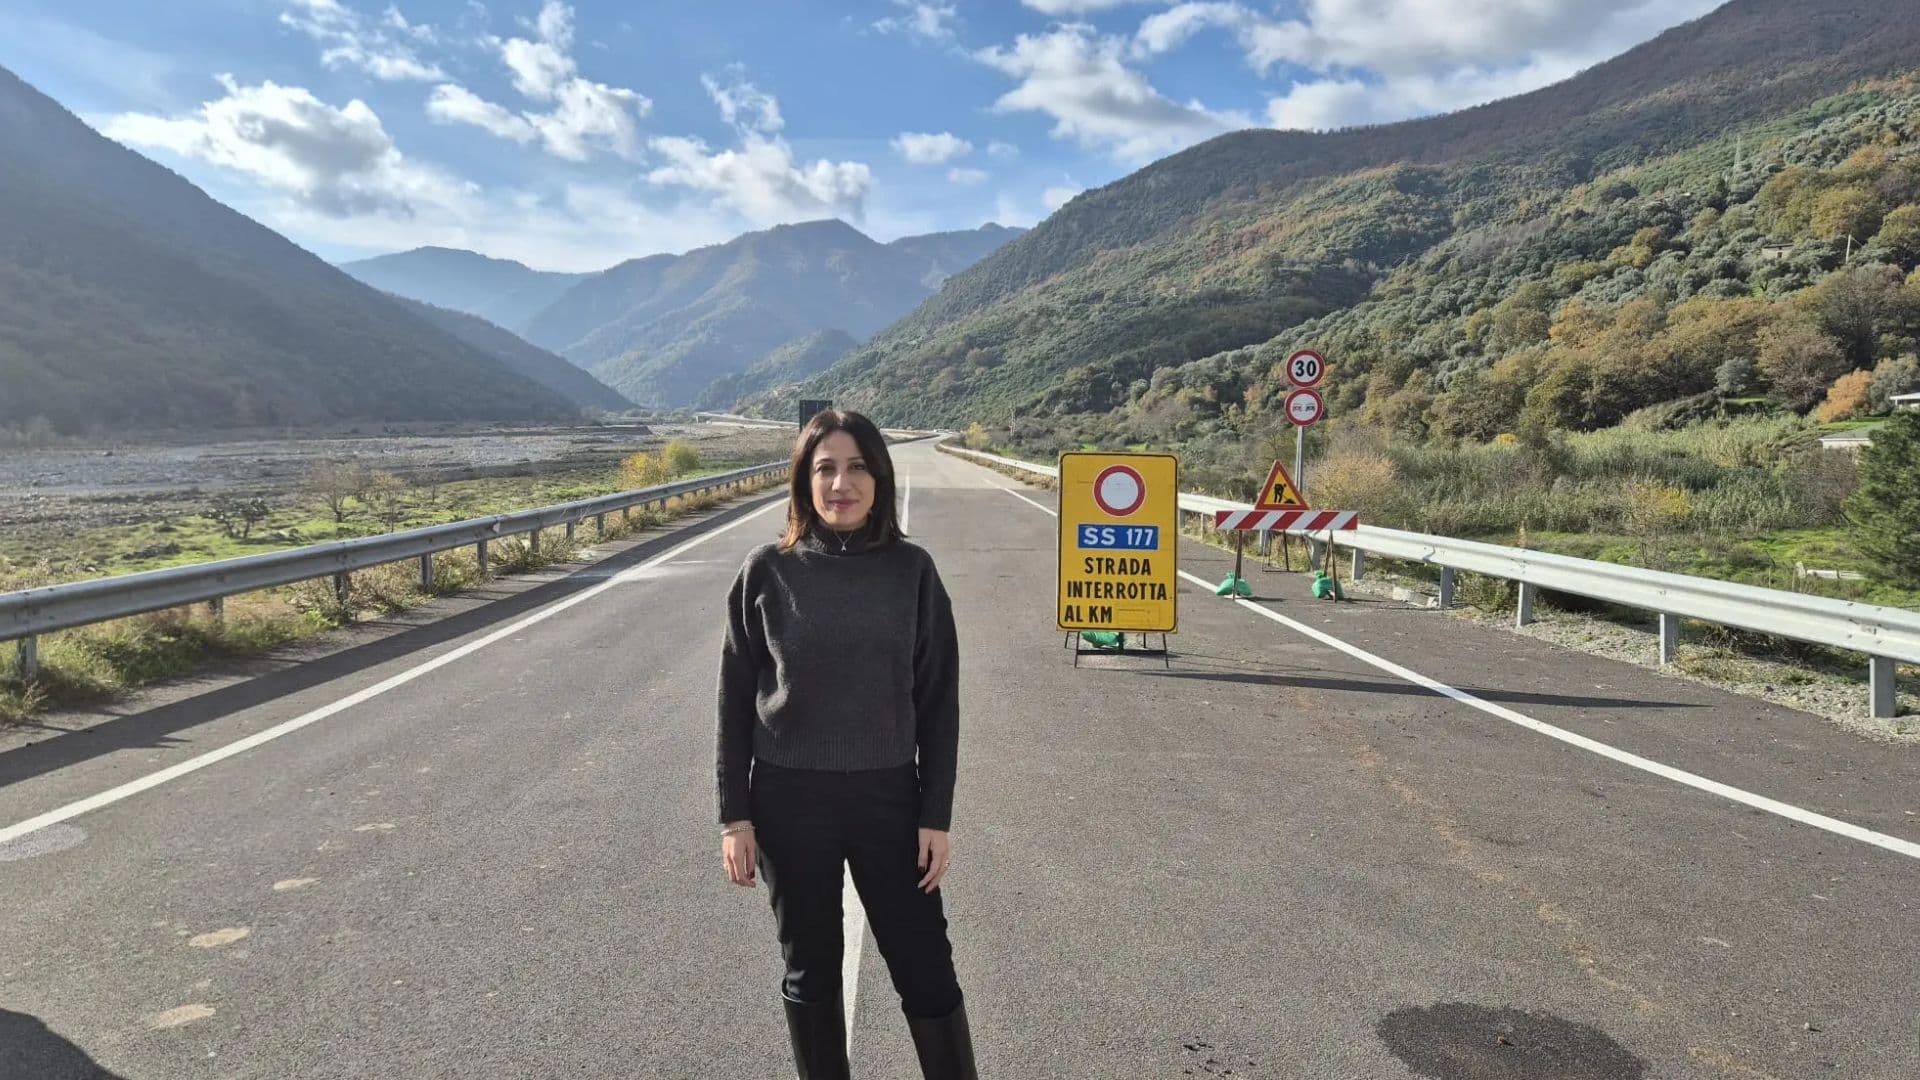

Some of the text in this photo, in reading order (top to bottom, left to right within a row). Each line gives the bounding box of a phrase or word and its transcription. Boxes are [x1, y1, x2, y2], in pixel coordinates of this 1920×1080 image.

[1295, 360, 1317, 377] 30
[1083, 527, 1154, 547] SS 177
[1084, 557, 1152, 576] STRADA
[1067, 581, 1168, 601] INTERROTTA
[1064, 605, 1113, 623] AL KM
